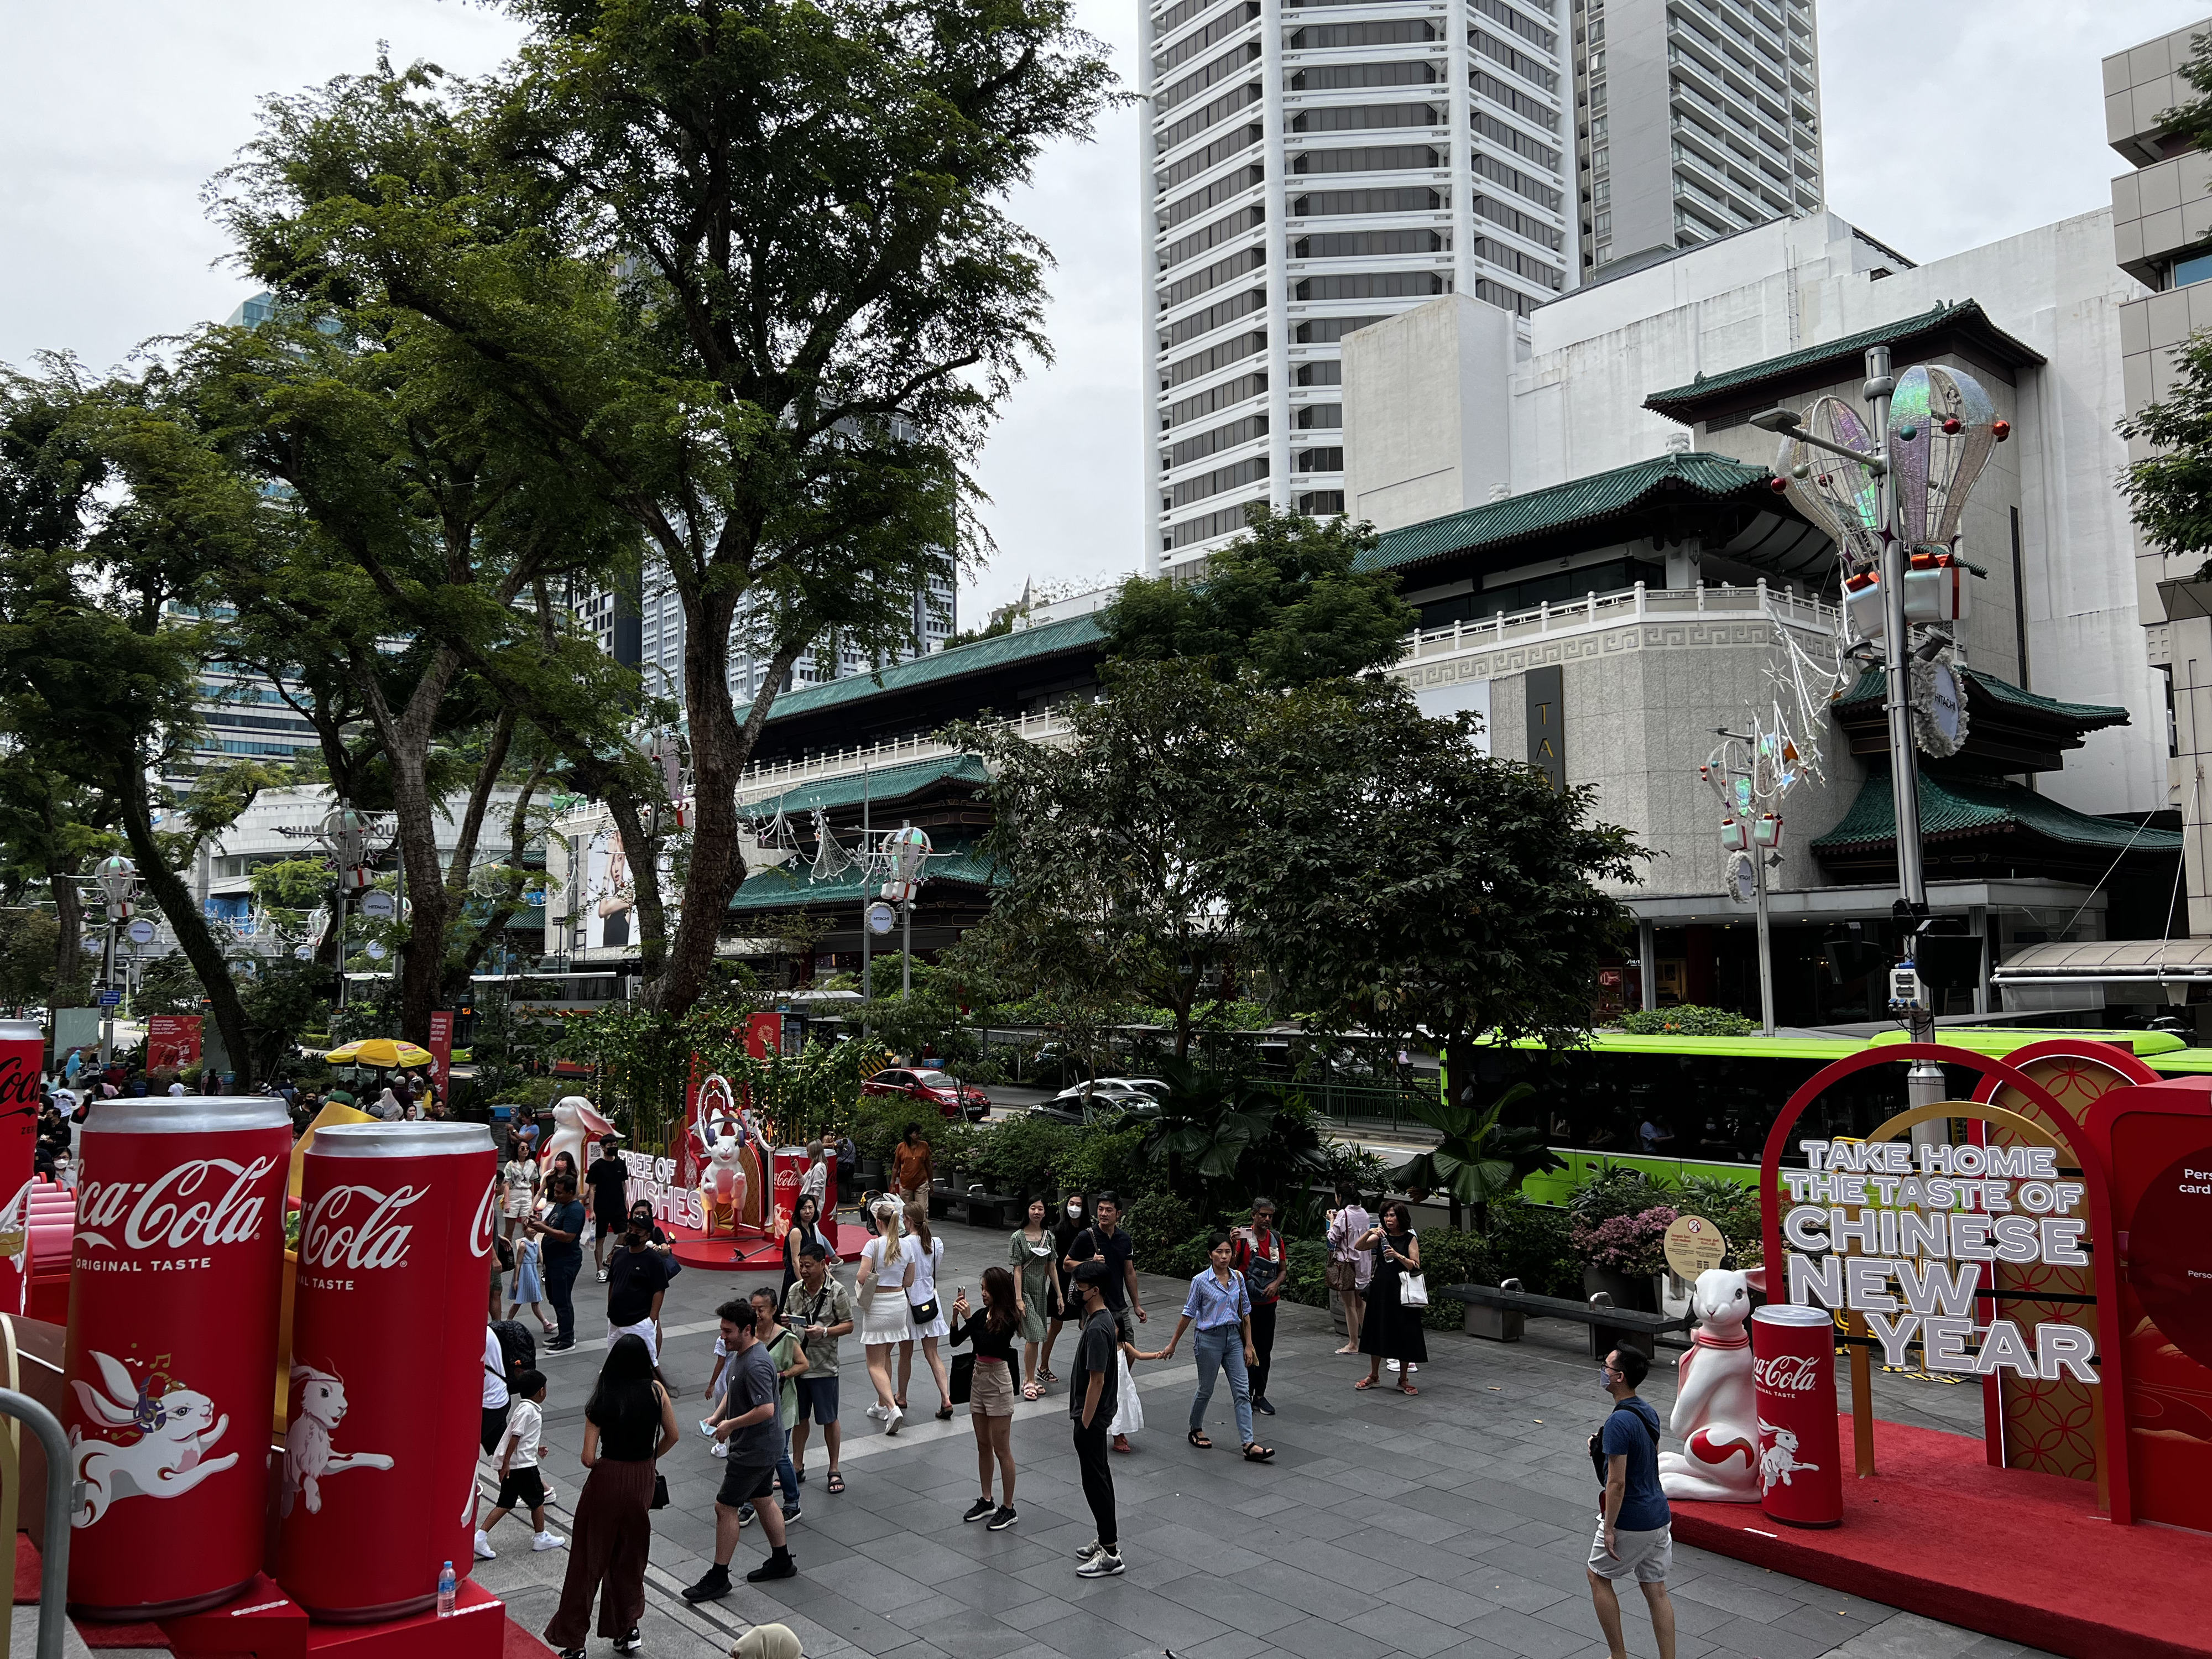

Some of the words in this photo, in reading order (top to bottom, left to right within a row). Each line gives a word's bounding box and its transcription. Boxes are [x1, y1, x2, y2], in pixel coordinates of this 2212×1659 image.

[1935, 693, 1956, 711] HITACHI
[655, 1157, 677, 1184] OF
[1799, 1139, 1914, 1175] TAKE
[1919, 1144, 2058, 1179] HOME
[1782, 1171, 1869, 1205] THE
[1871, 1175, 2012, 1212] TASTE
[2017, 1181, 2085, 1214] OF
[2179, 1185, 2211, 1194] card
[1783, 1205, 2089, 1266] CHINESE
[76, 1258, 142, 1271] ORIGINAL
[150, 1257, 211, 1271] TASTE
[312, 1278, 354, 1290] TASTE
[1787, 1253, 1981, 1318] NEW
[1863, 1311, 2100, 1384] YEAR
